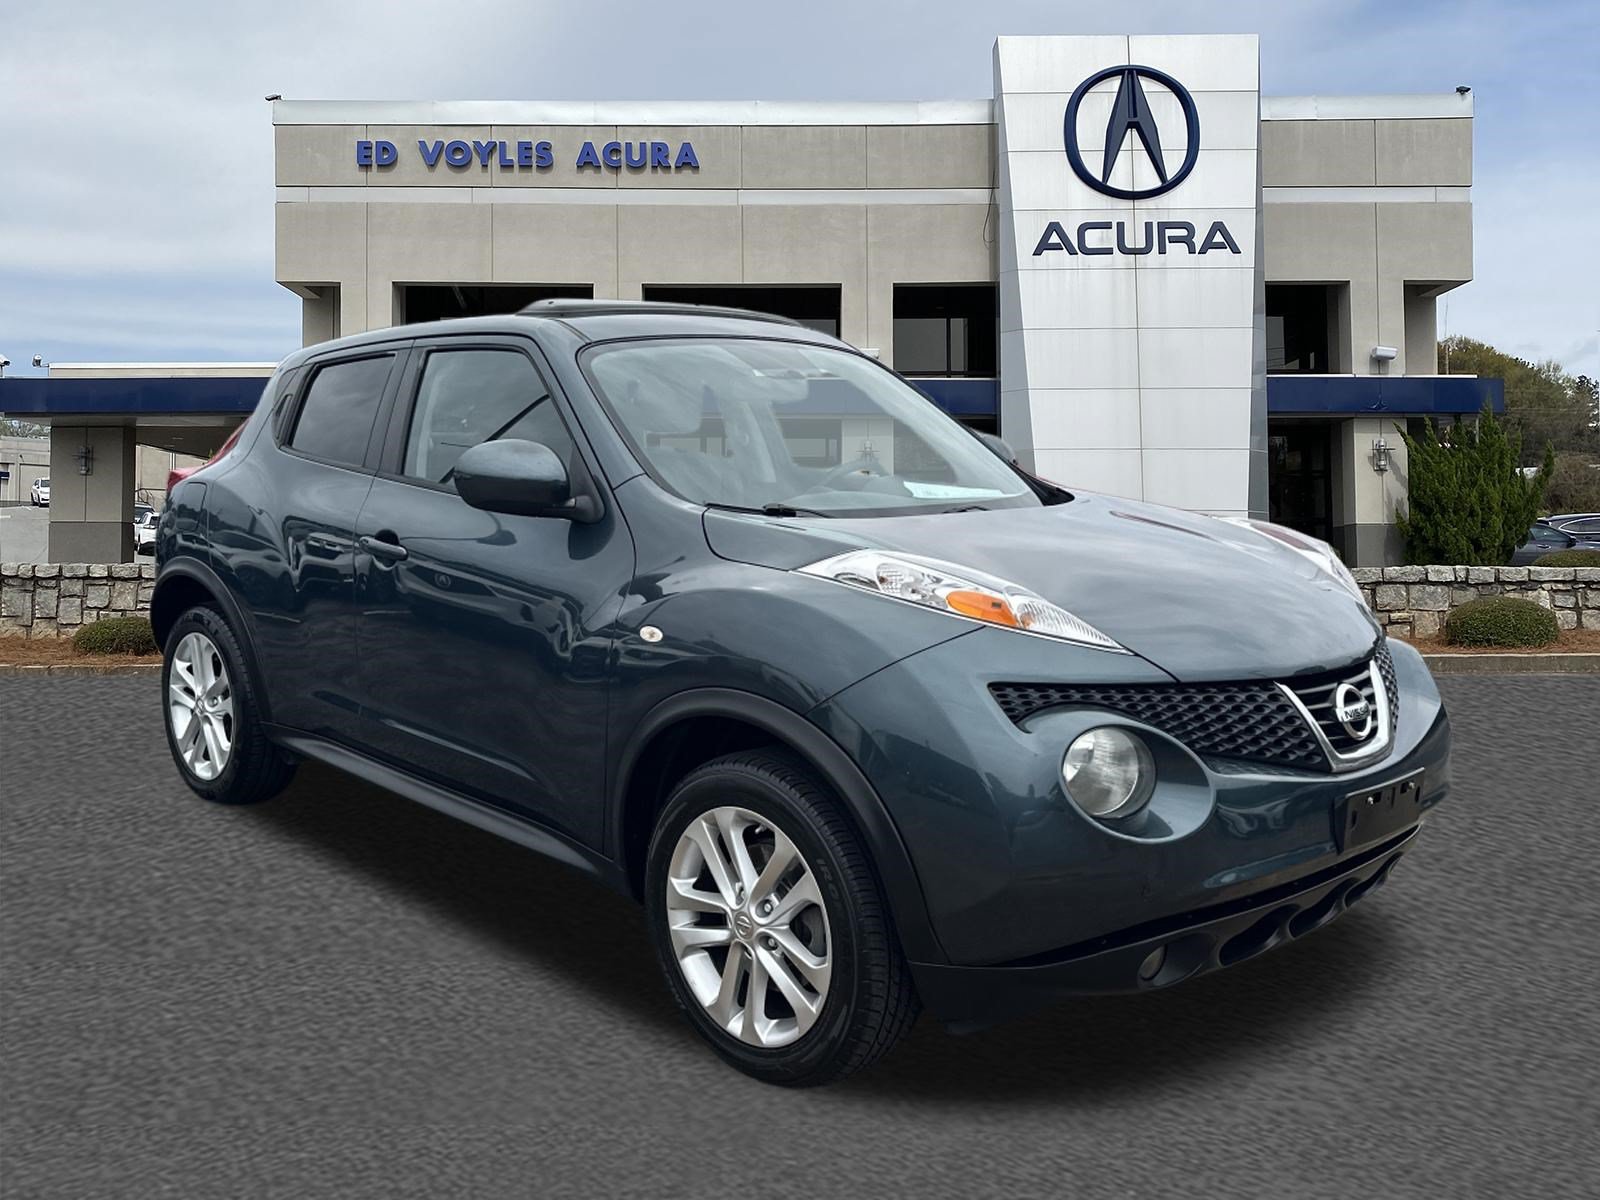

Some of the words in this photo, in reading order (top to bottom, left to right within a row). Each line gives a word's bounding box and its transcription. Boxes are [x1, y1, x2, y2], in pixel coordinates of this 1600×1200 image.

[356, 140, 398, 167] ED
[418, 140, 554, 168] VOYLES
[576, 140, 700, 168] ACURA
[1032, 221, 1242, 257] ACURA
